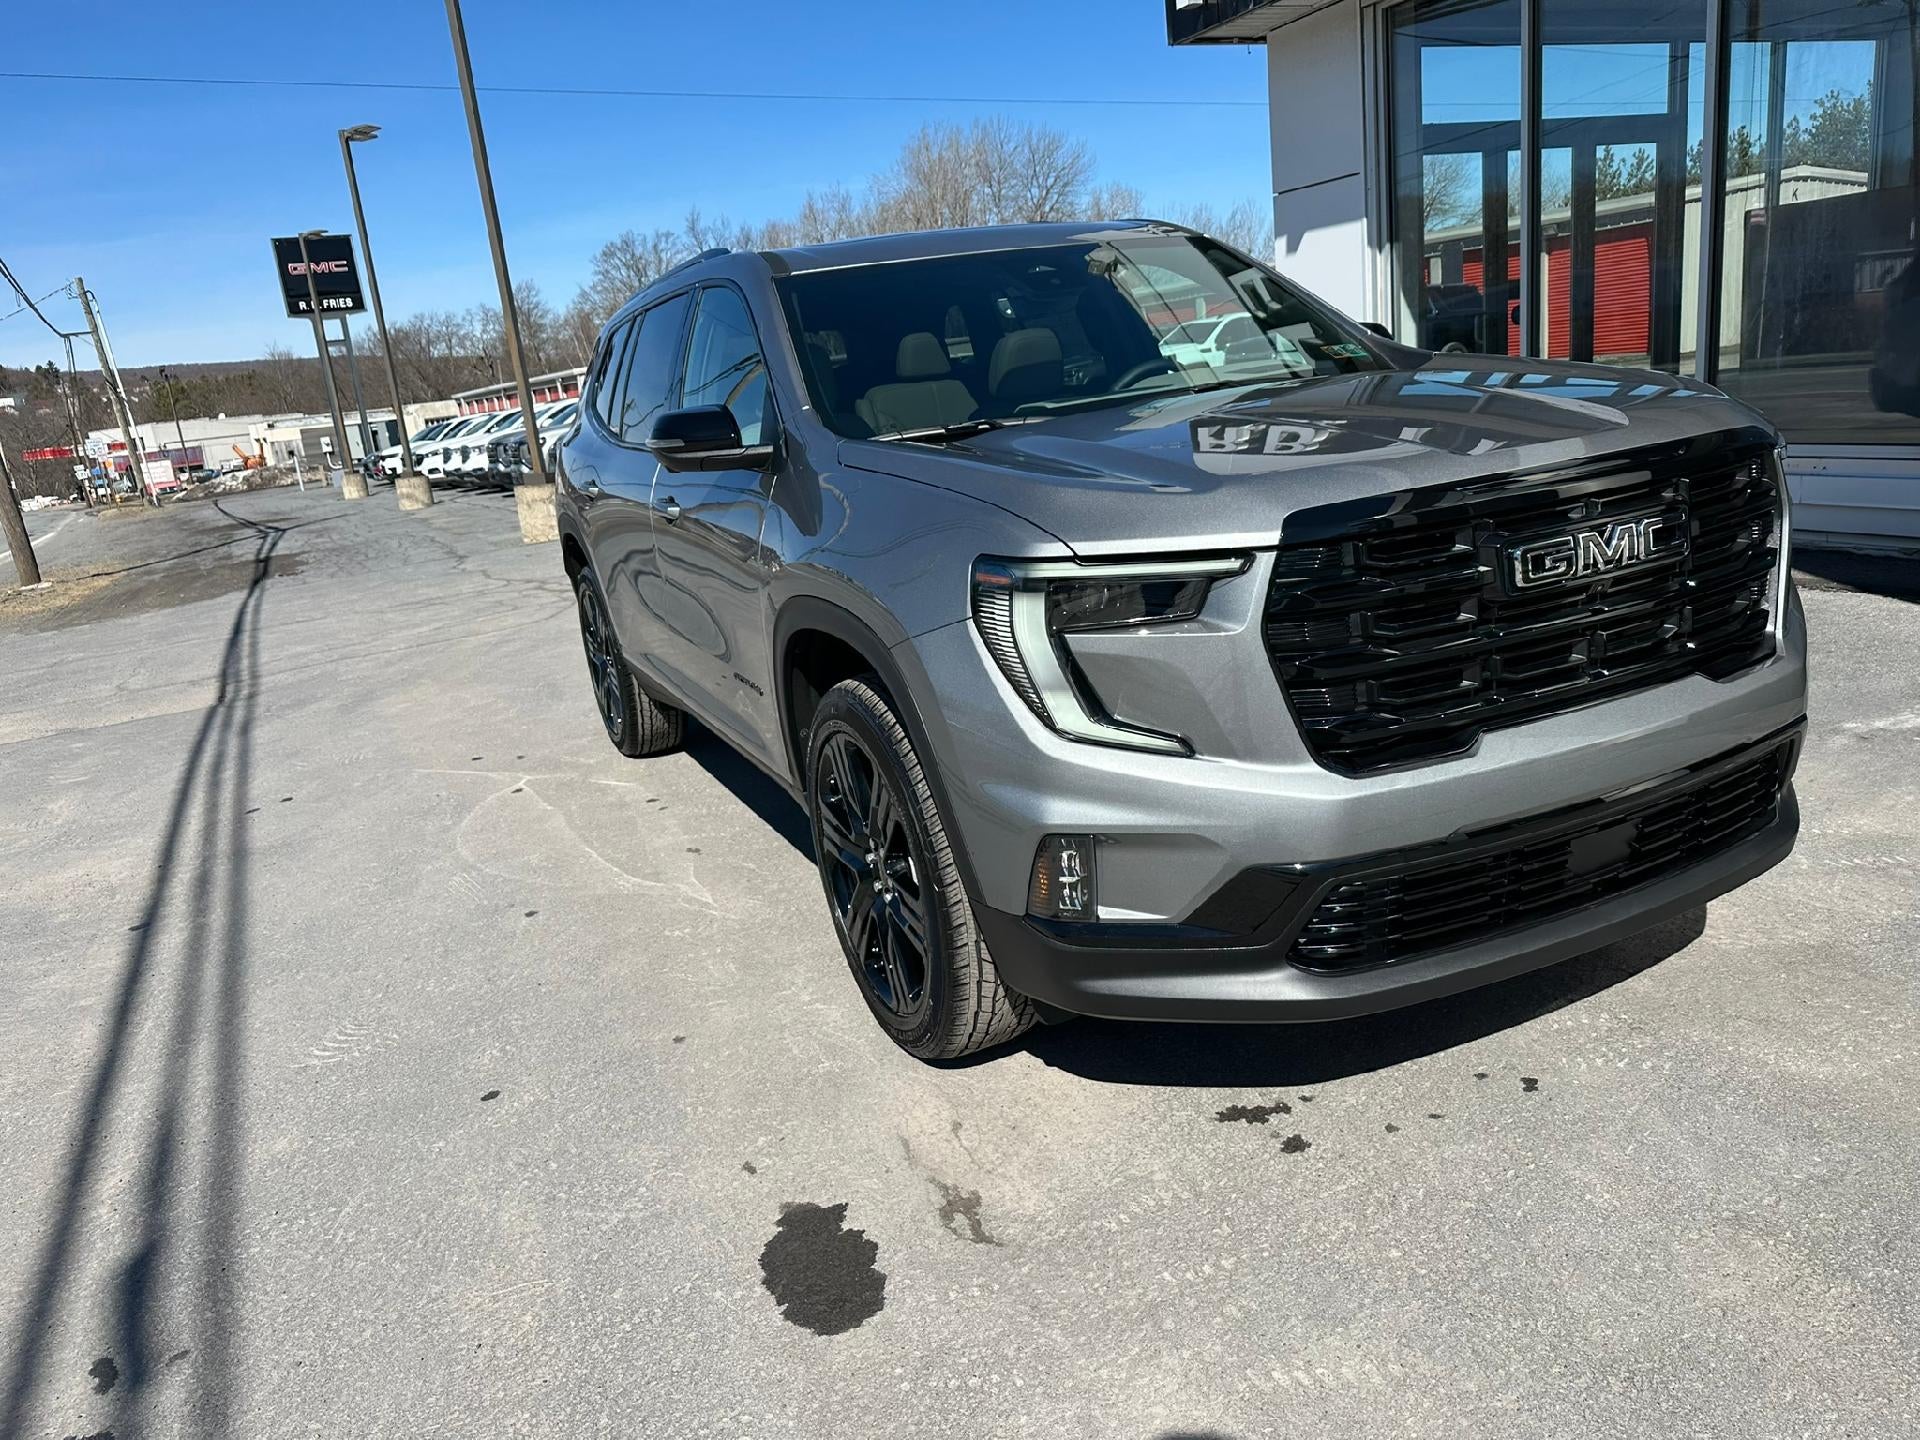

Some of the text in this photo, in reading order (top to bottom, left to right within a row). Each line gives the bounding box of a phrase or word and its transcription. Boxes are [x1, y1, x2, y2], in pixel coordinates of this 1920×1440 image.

[288, 260, 348, 276] GMC
[322, 297, 354, 309] FRIES
[1513, 517, 1688, 588] GMC
